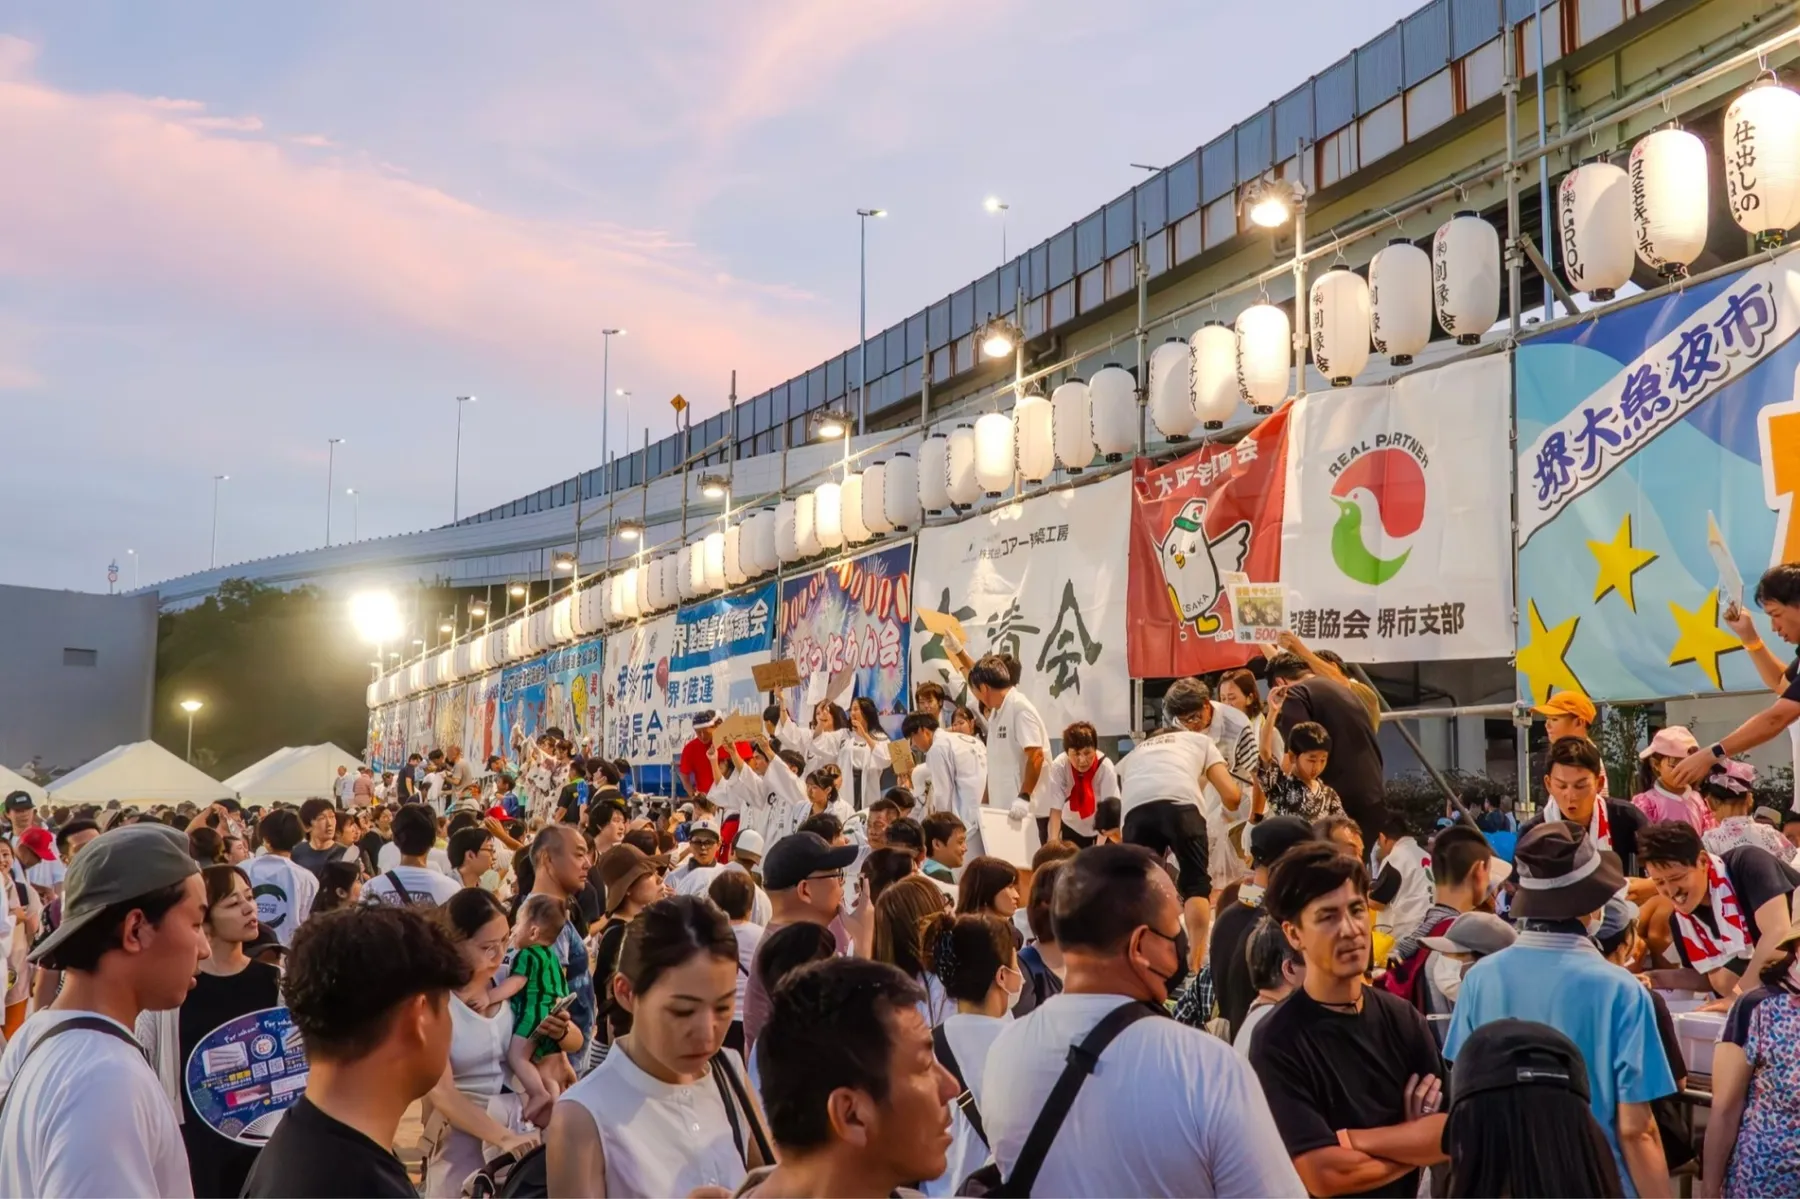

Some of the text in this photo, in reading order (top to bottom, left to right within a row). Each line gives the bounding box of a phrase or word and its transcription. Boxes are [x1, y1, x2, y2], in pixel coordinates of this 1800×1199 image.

[1733, 120, 1760, 212] 仕出しの
[1533, 283, 1775, 502] 堺大魚夜市
[1328, 431, 1429, 478] REAL PARTNER
[1182, 593, 1210, 613] SAKA
[1377, 601, 1466, 639] 堺市支部
[1254, 627, 1278, 641] 500
